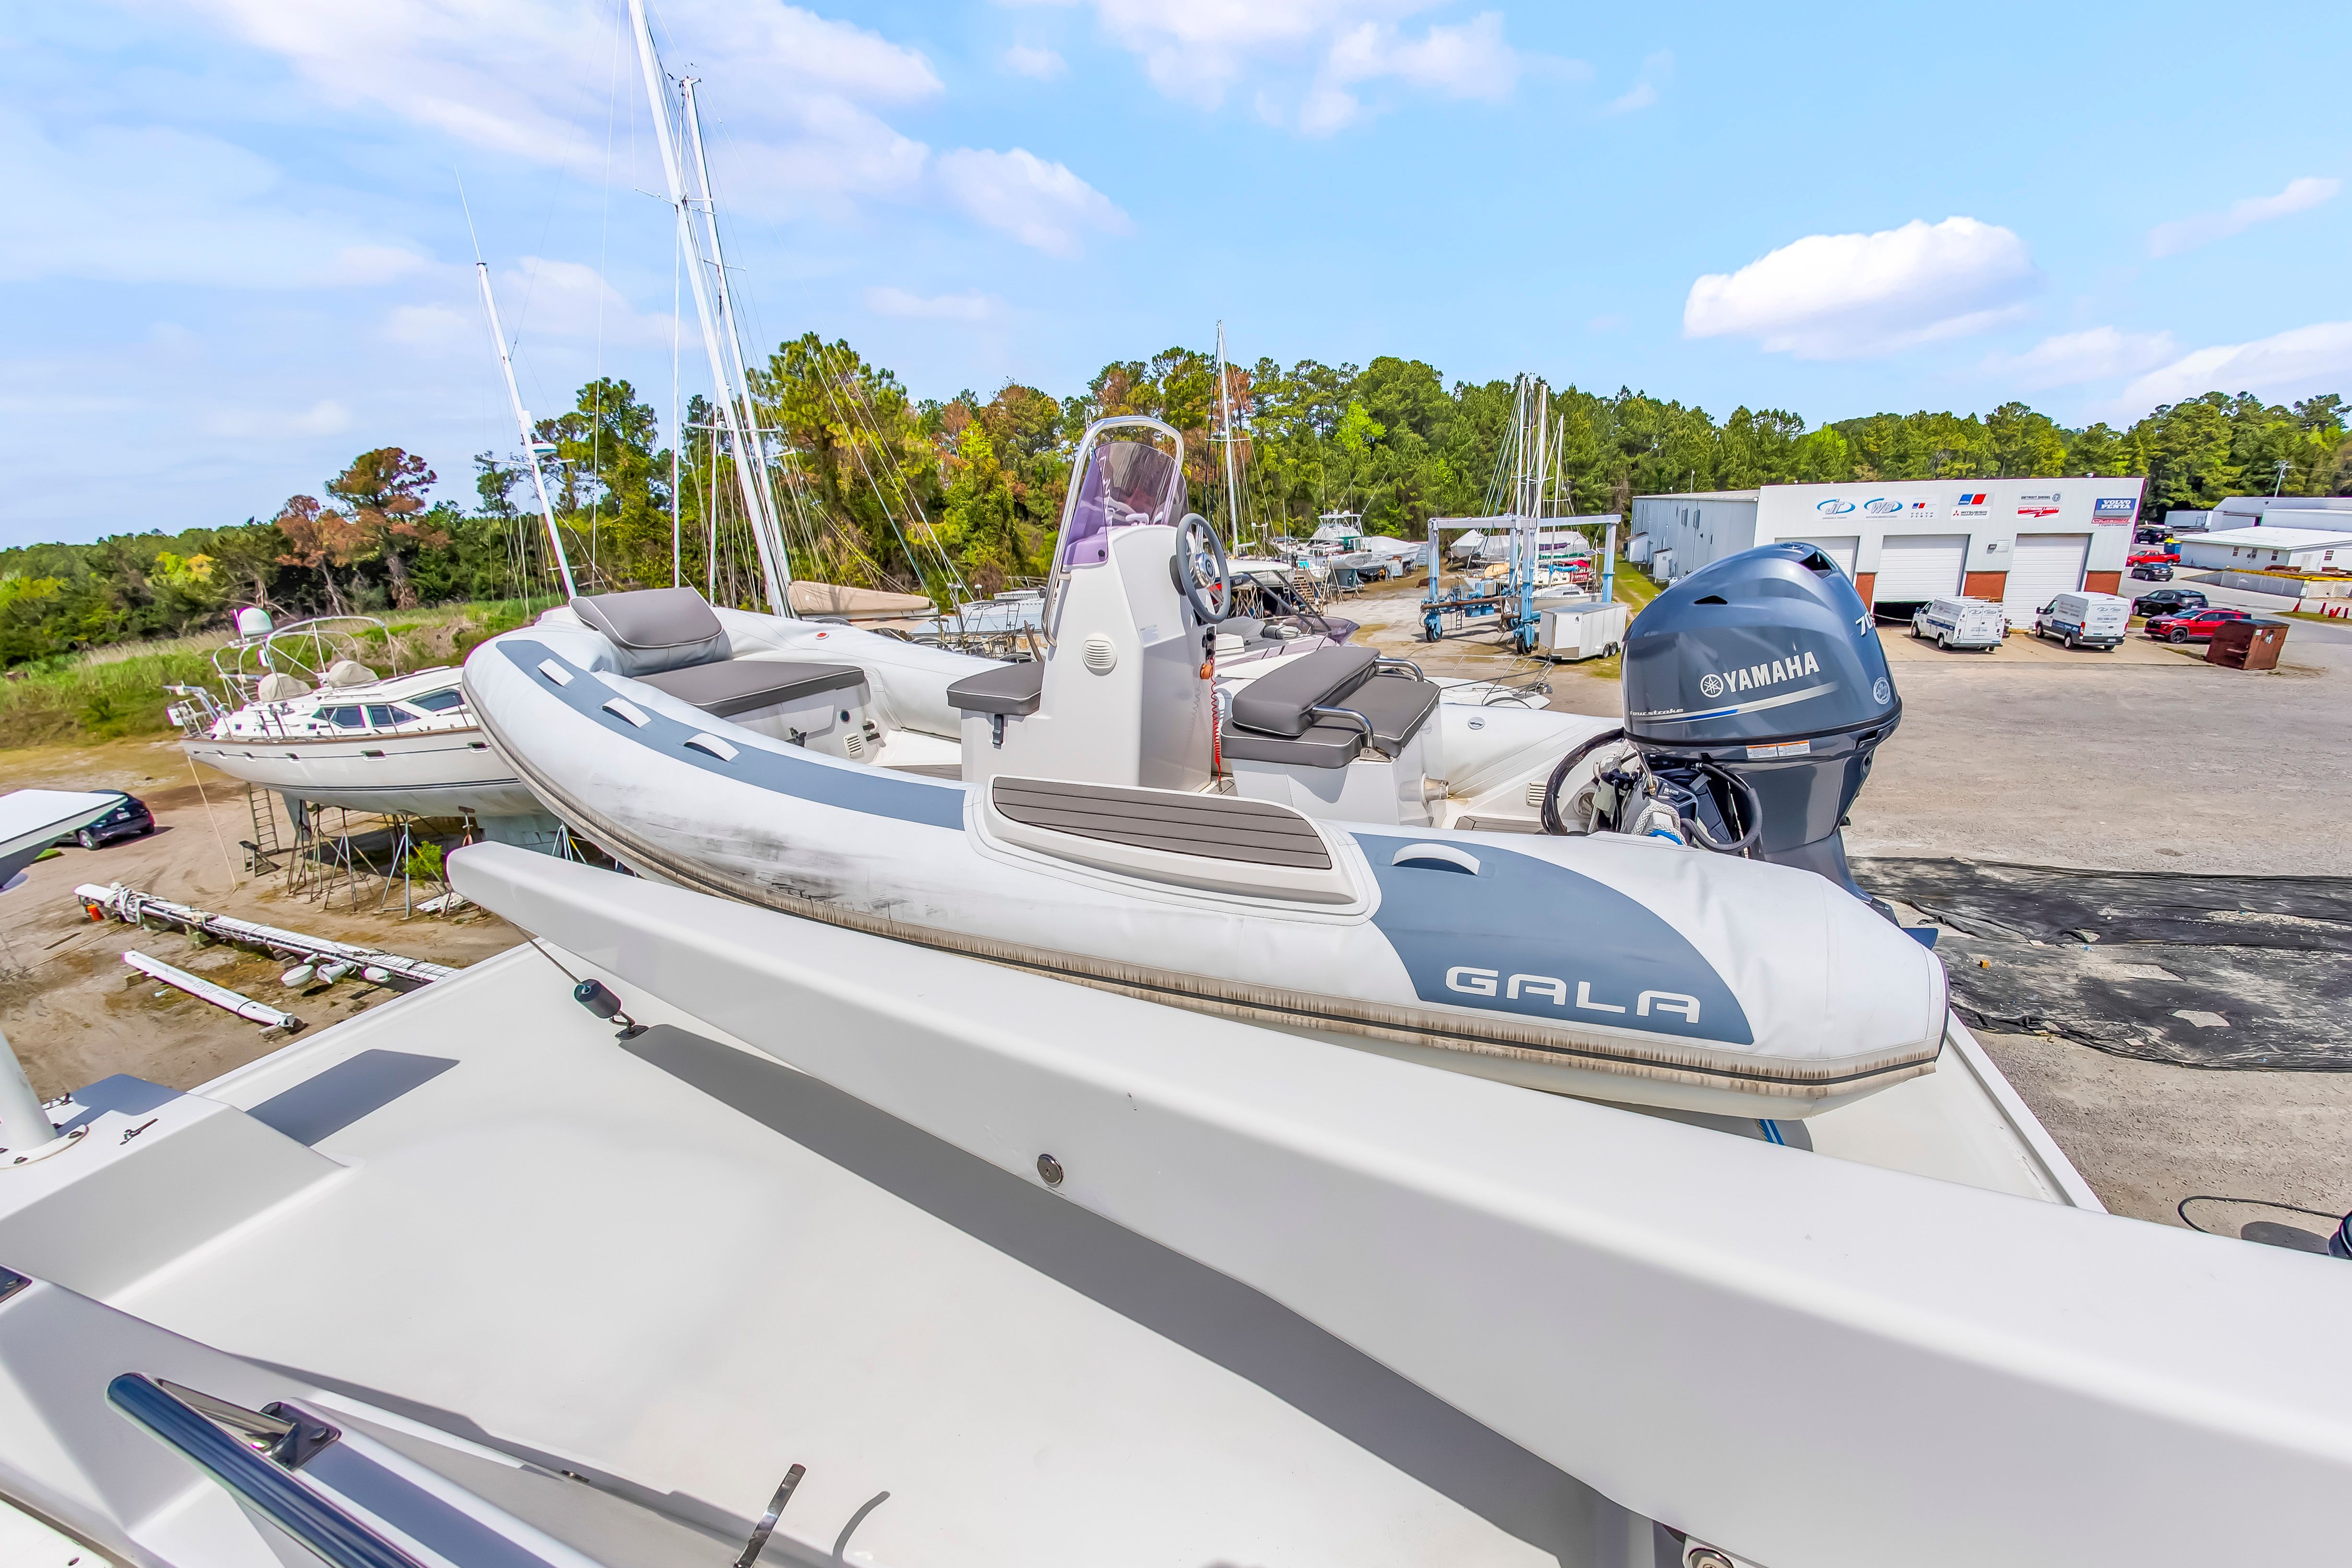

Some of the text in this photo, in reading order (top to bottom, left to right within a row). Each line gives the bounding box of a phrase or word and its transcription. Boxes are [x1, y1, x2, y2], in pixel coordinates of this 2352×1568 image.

[1871, 501, 1895, 514] WB
[1856, 610, 1873, 636] 70
[1722, 651, 1820, 692] YAMAHA
[1446, 966, 1701, 1024] GALA
